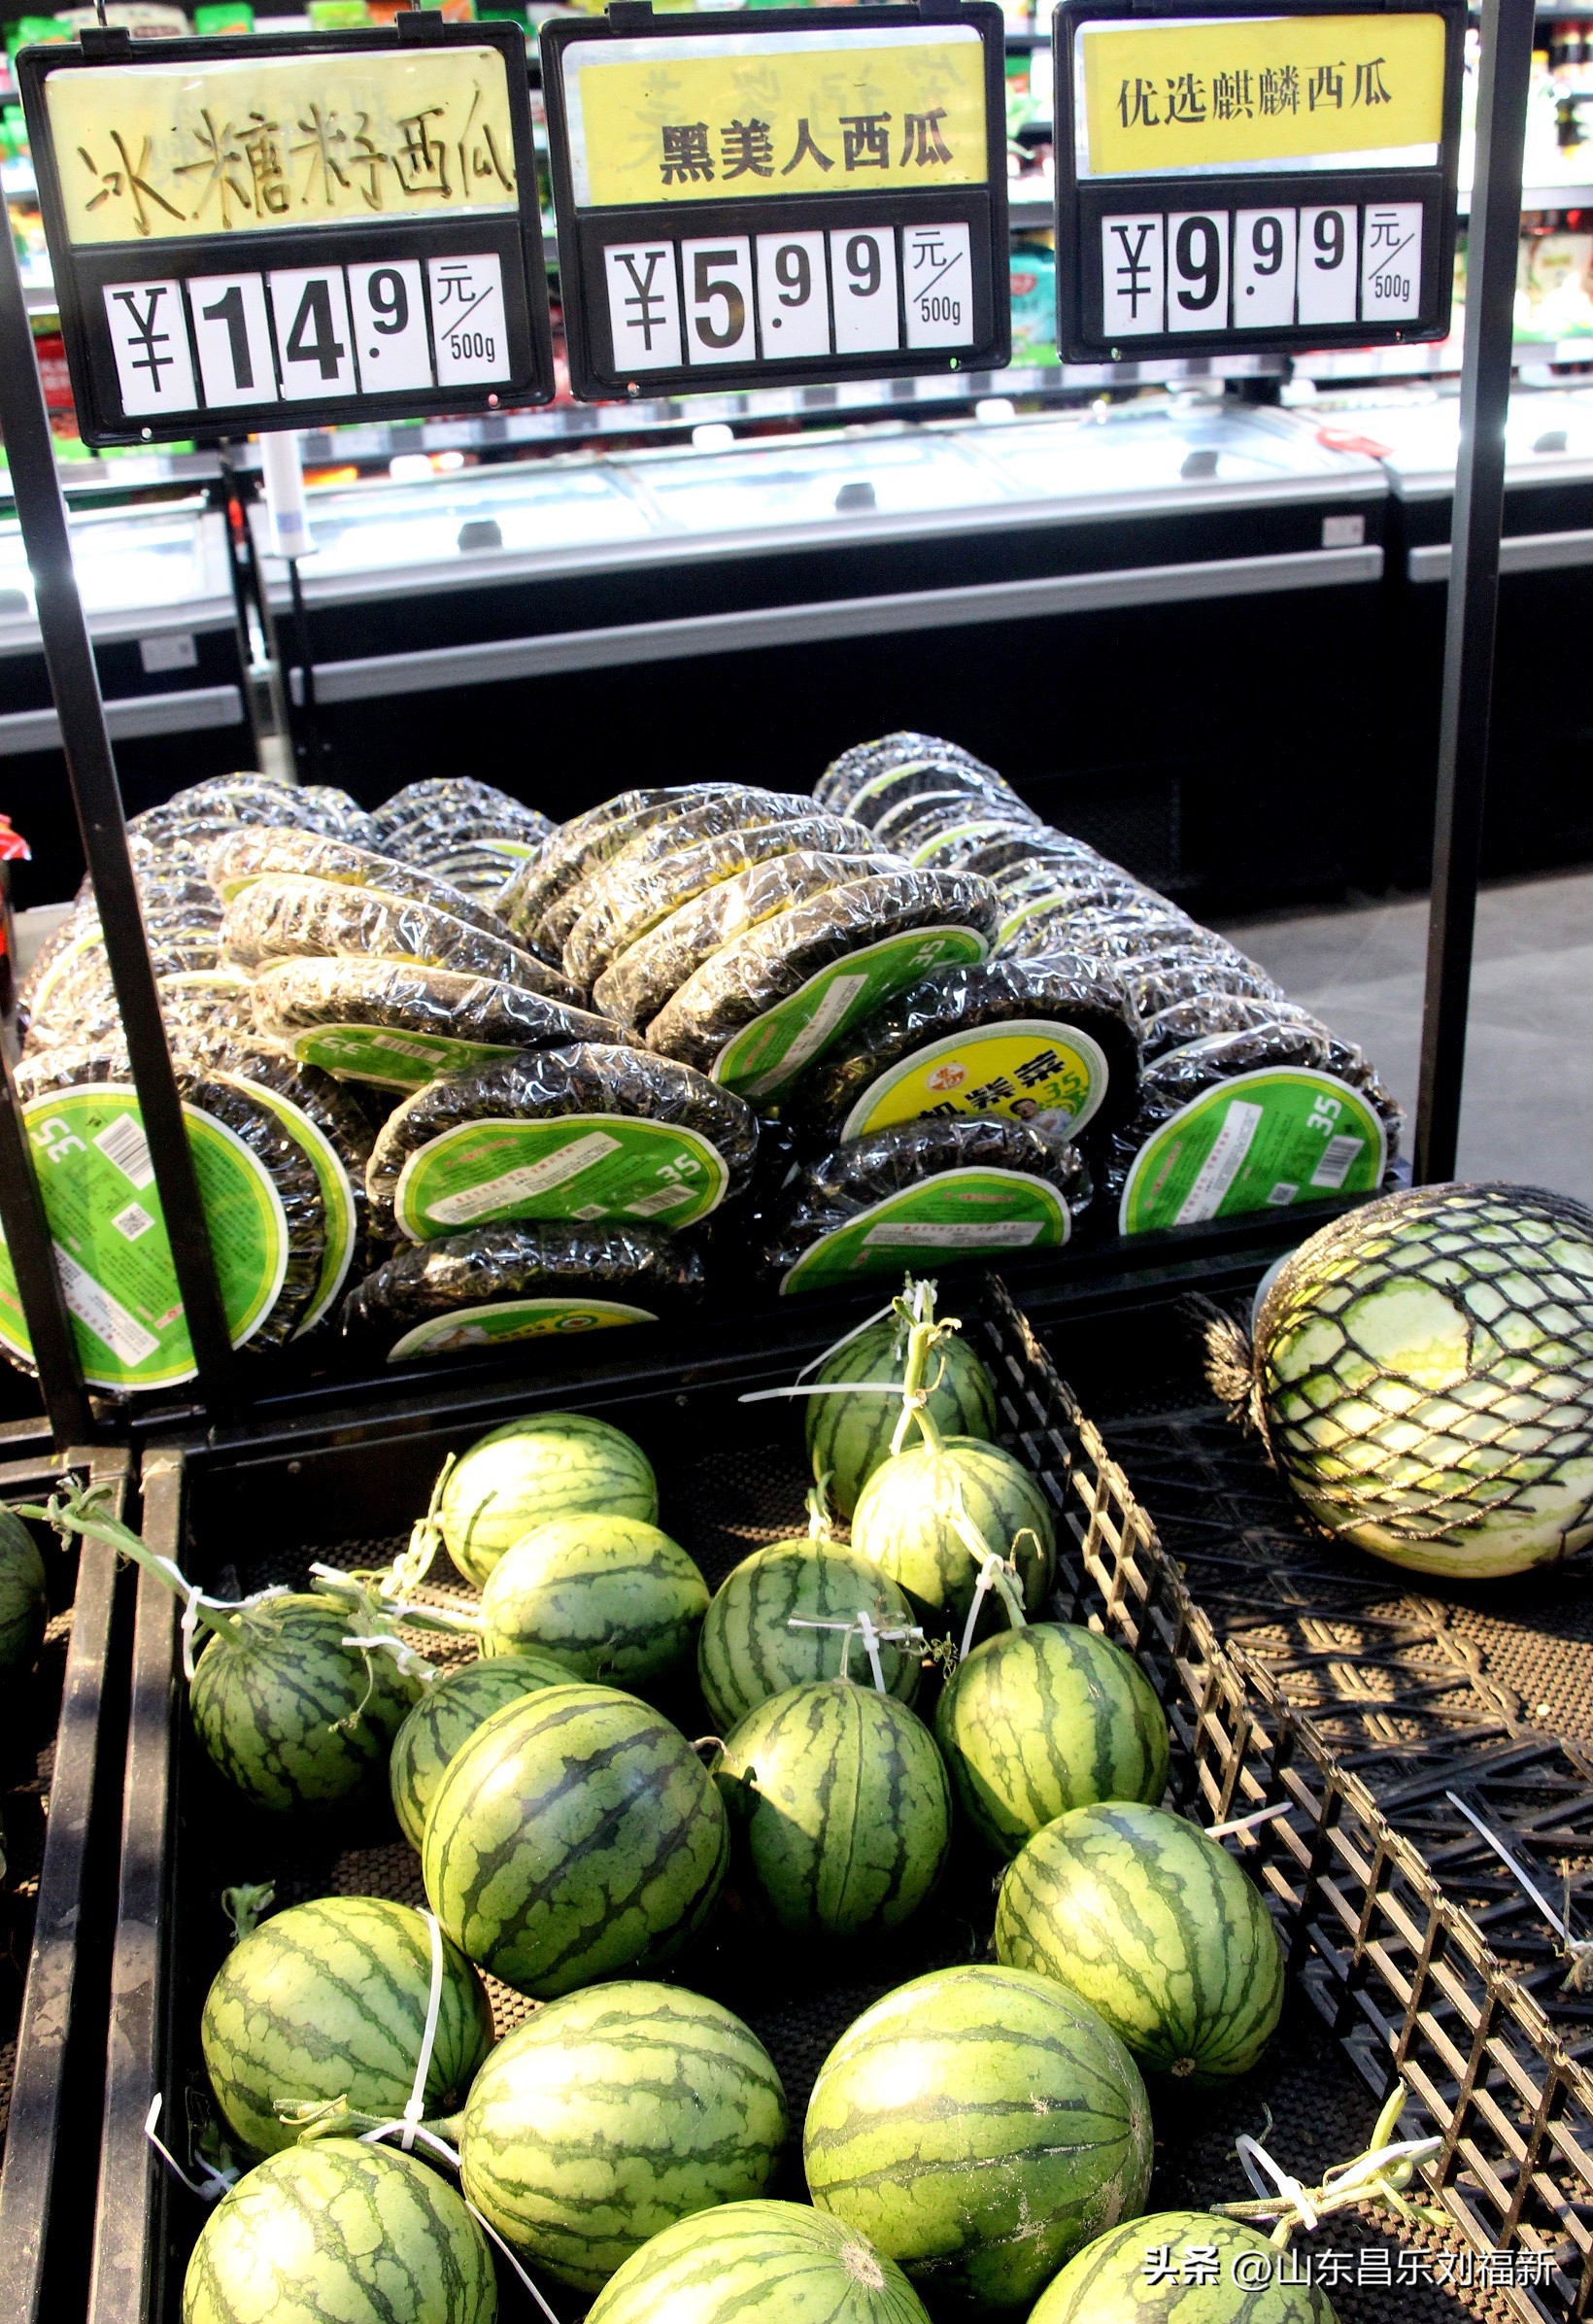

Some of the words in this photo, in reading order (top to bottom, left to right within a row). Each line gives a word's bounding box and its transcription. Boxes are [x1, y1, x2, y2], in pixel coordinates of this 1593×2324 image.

[1117, 57, 1393, 128] 优选麒麟西瓜
[660, 107, 954, 185] 黑美人西瓜
[1042, 1071, 1081, 1102] 35
[1306, 1095, 1341, 1137] 35
[30, 1117, 87, 1163] 35
[656, 1153, 701, 1184] 35
